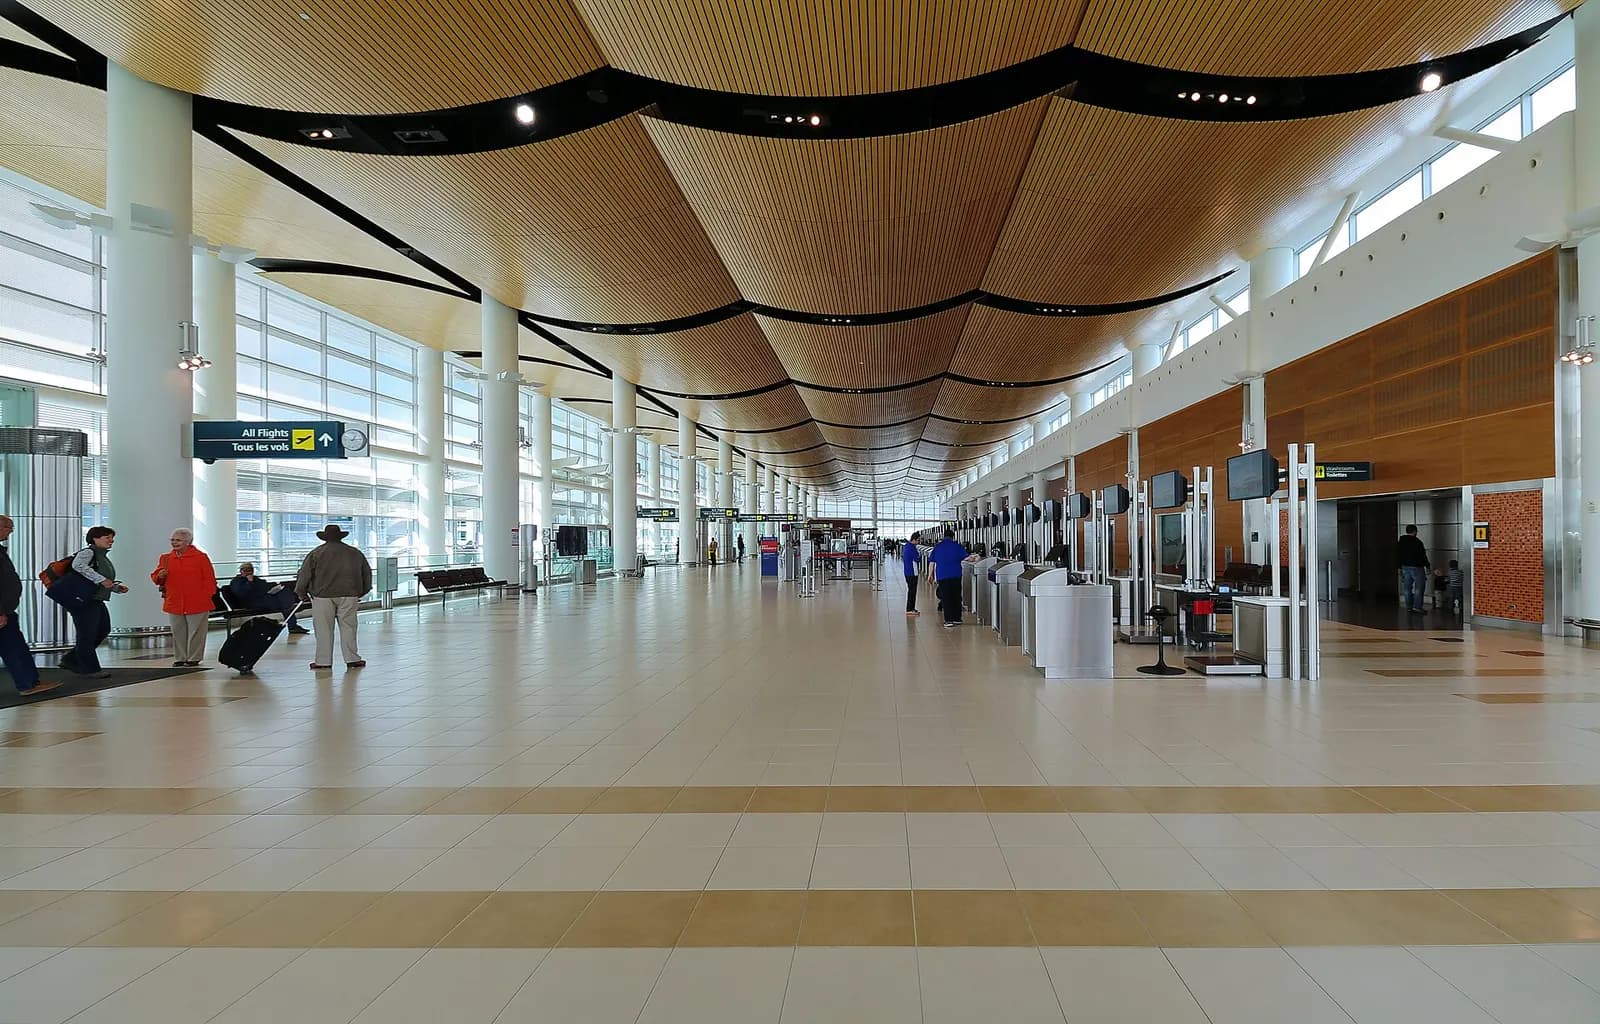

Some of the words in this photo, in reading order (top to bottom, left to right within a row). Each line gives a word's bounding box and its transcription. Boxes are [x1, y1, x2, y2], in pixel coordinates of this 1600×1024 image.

[242, 428, 255, 437] All
[258, 428, 289, 439] Flights
[231, 442, 254, 451] Tous
[256, 442, 269, 451] les
[270, 442, 289, 451] vols
